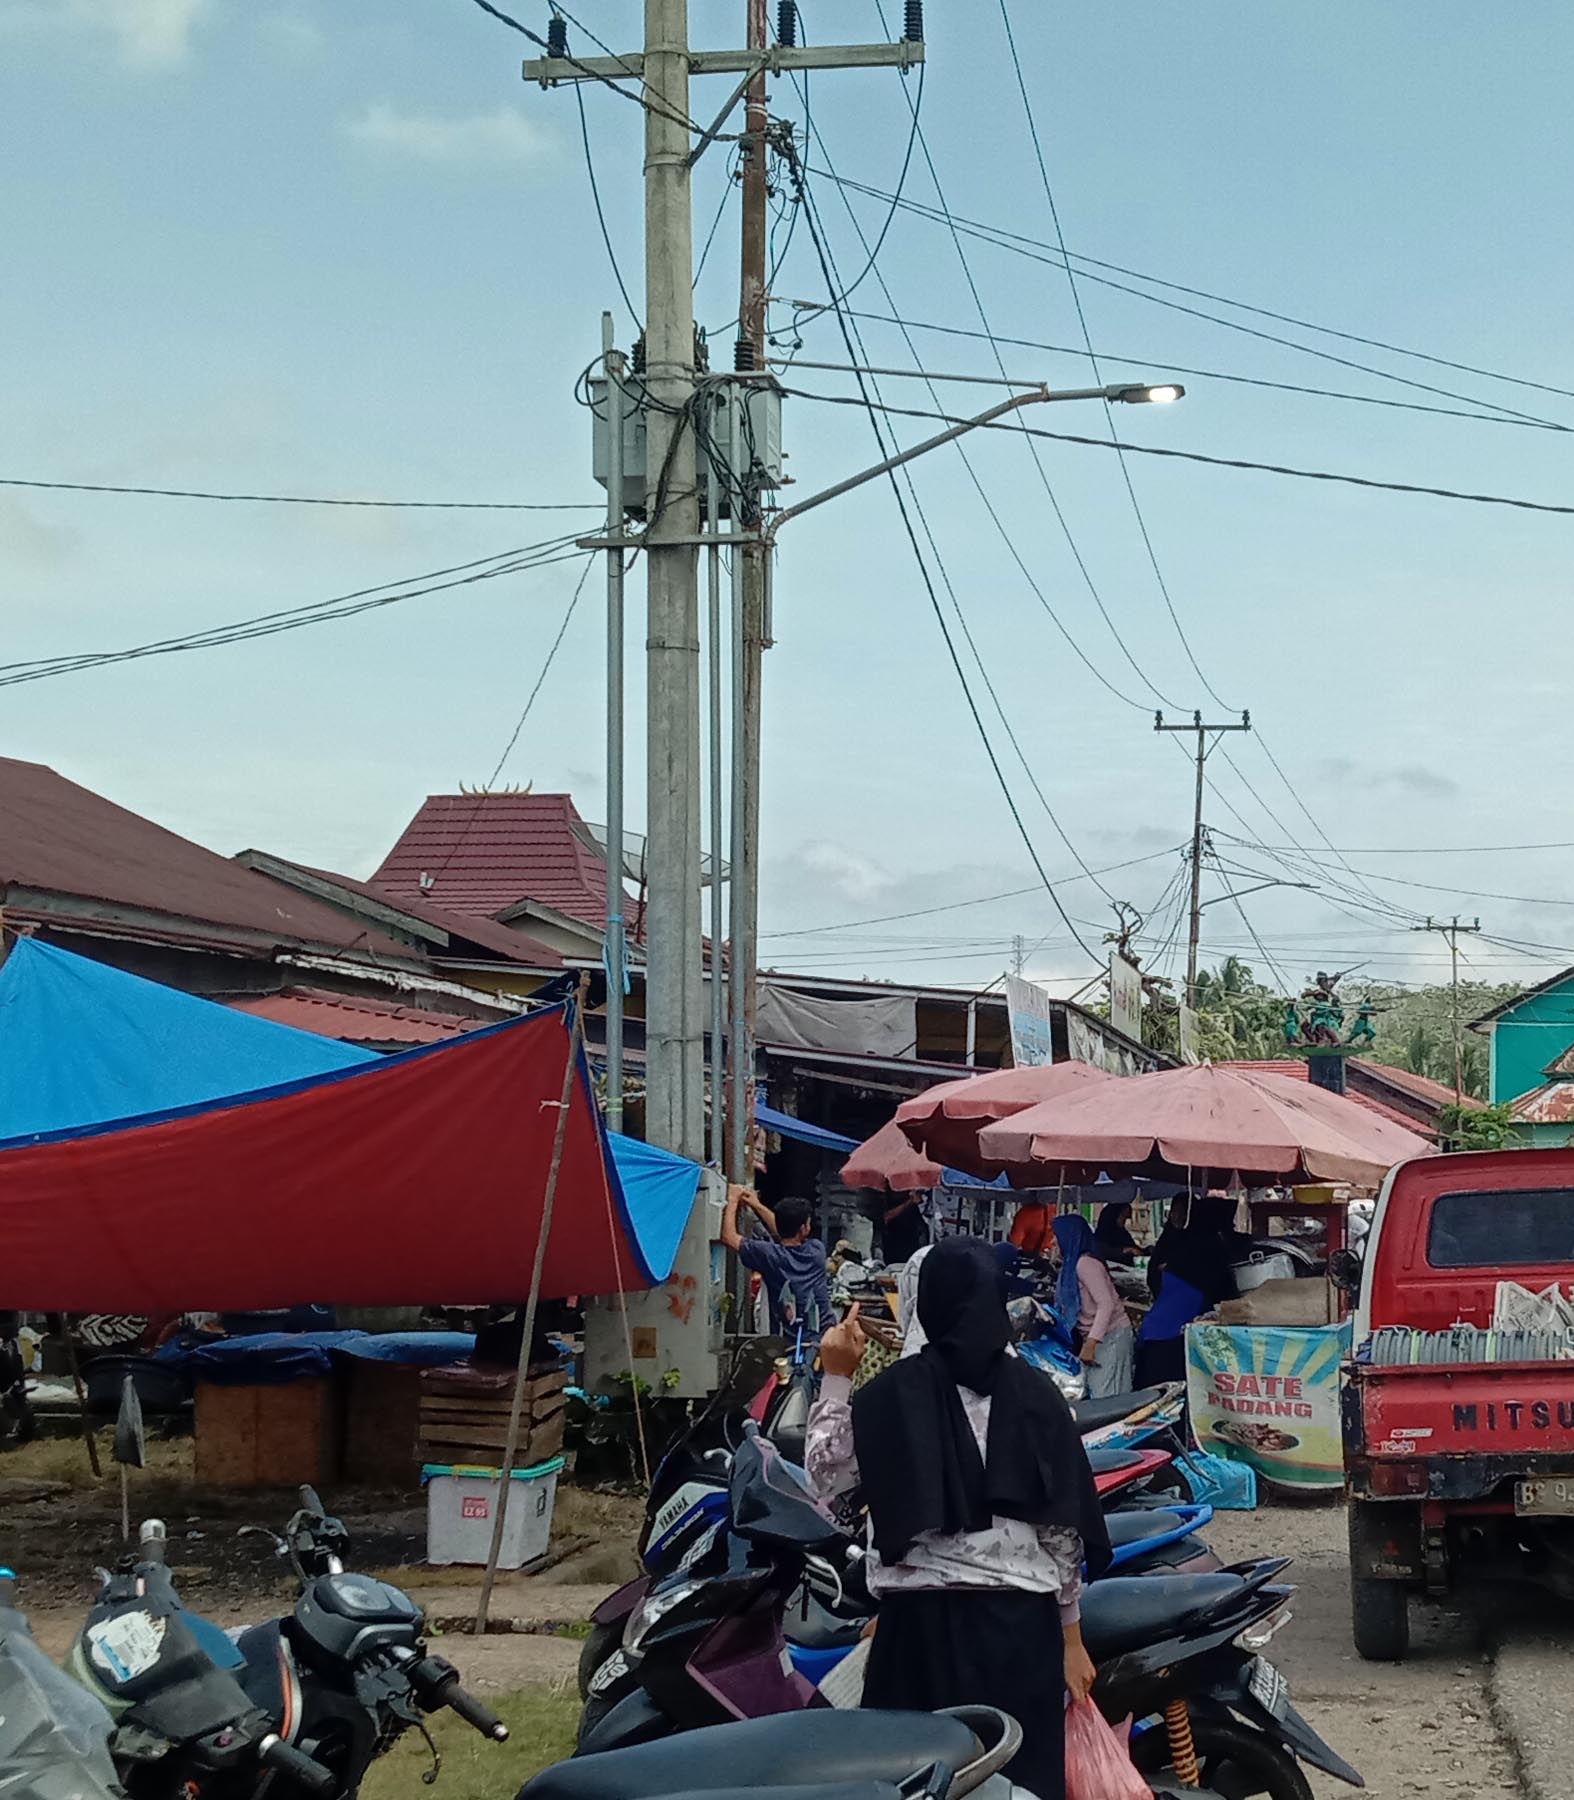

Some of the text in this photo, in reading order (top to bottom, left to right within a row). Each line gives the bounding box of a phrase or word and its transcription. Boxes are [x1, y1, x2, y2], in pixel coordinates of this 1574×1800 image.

[1213, 1373, 1303, 1399] SATE
[1207, 1391, 1313, 1419] PADANG
[659, 1496, 690, 1531] YAMAHA
